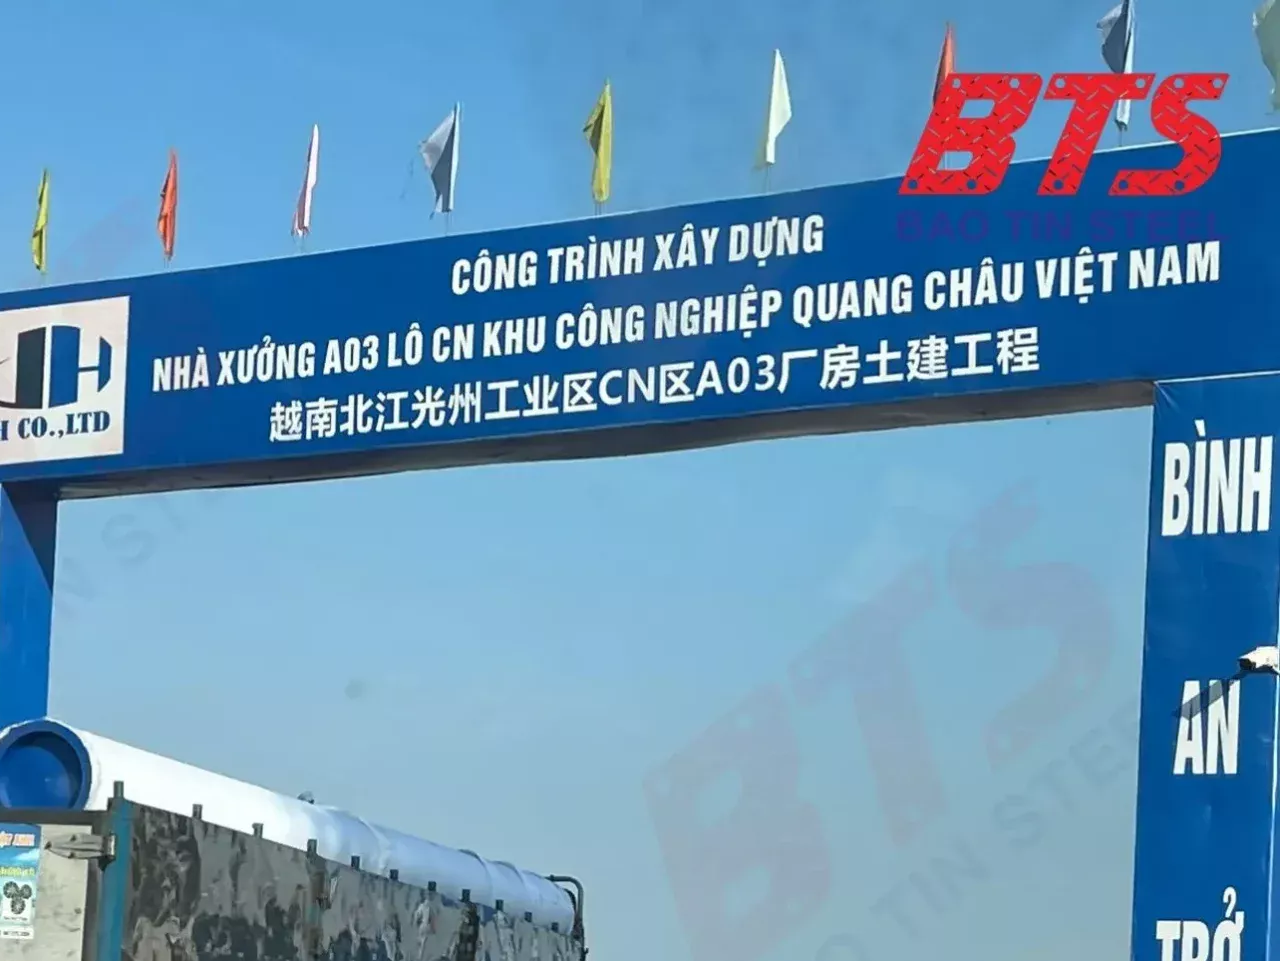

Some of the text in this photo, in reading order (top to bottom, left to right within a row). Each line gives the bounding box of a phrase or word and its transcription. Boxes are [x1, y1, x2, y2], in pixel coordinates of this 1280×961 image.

[451, 214, 825, 295] CÔNG TRÌNH XÂY DỰNG
[152, 240, 1221, 393] NHÀ XƯỞNG A03 LÔ CN KHU CÔNG NGHIỆP QUANG CHÂU VIỆT NAM
[18, 409, 111, 441] CO.,LTD
[1161, 420, 1273, 537] BÌNH
[1172, 679, 1241, 776] AN
